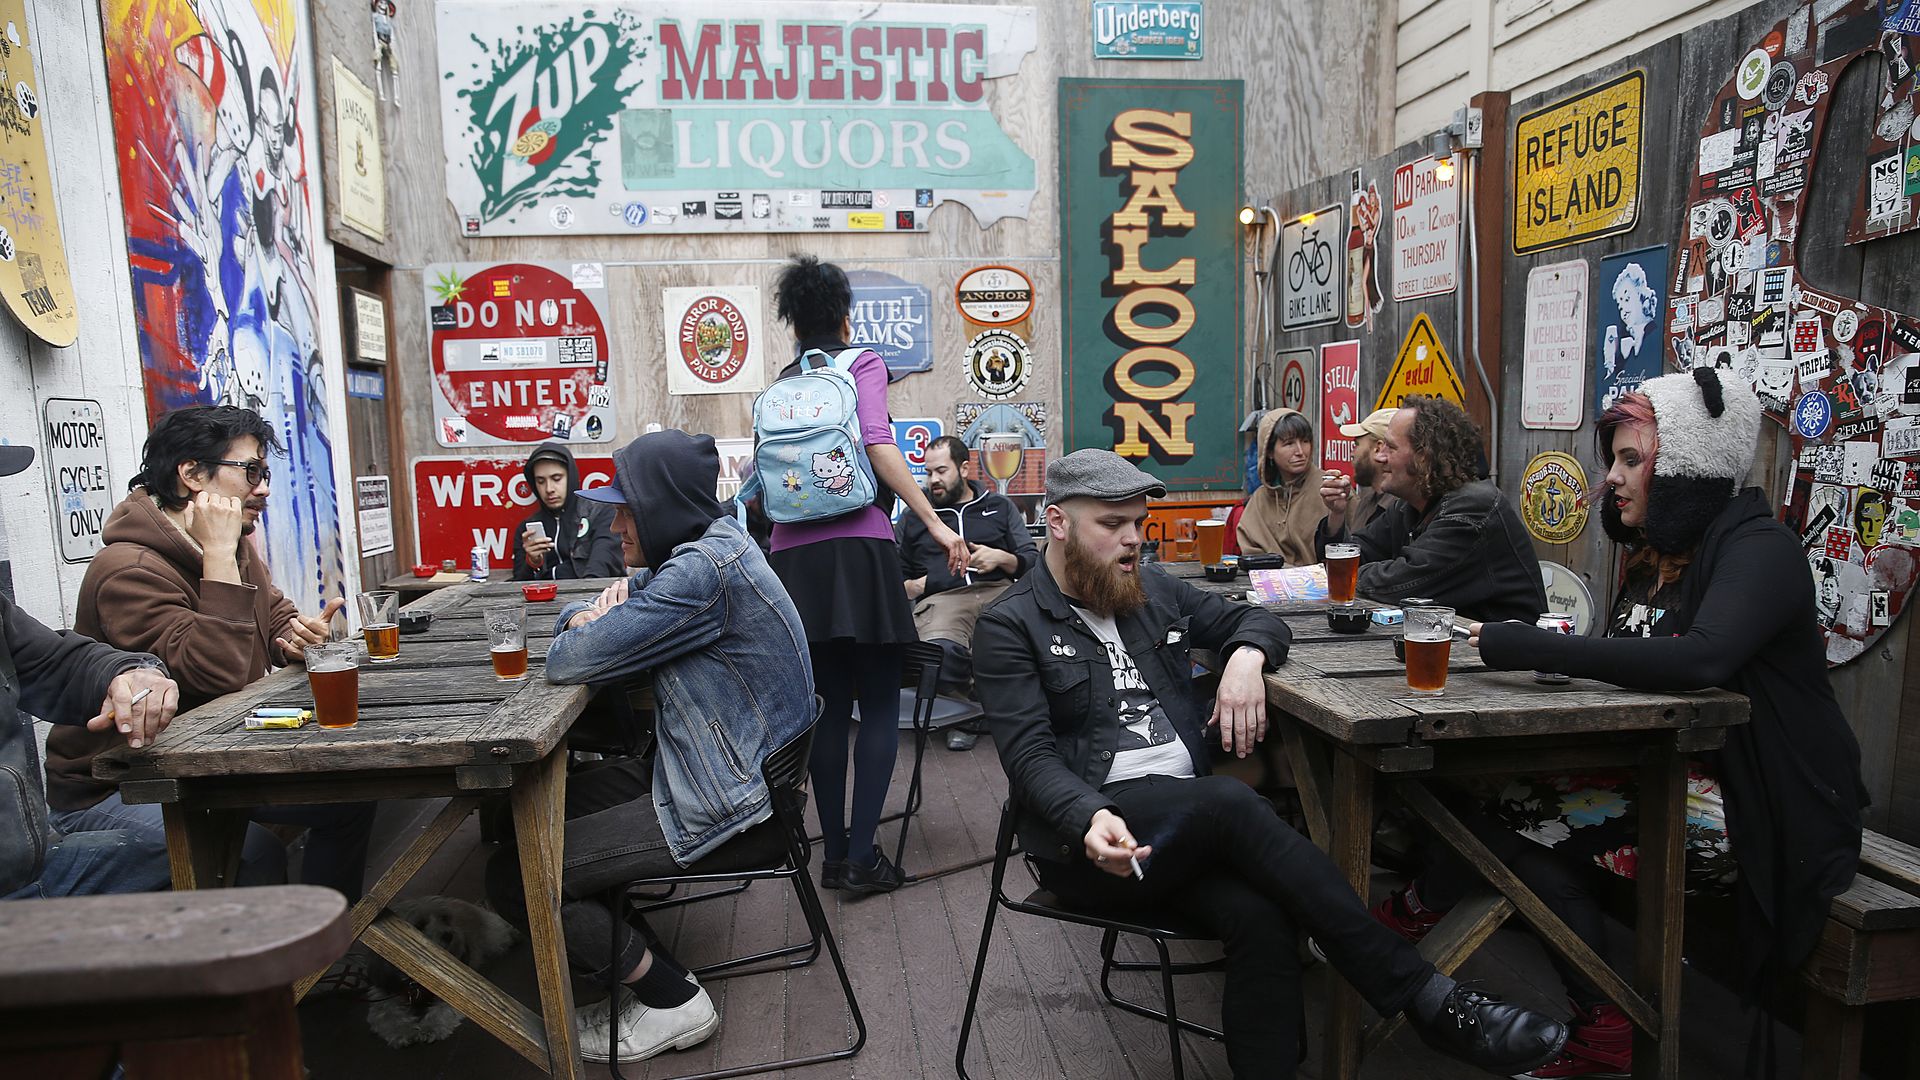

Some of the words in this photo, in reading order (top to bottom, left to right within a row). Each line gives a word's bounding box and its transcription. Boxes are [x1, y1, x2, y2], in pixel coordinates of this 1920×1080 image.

[1097, 3, 1199, 45] Underberg
[660, 23, 984, 103] MAJESTIC
[342, 97, 374, 141] JAMESON
[485, 24, 611, 197] 7UP
[676, 119, 972, 178] LIQUORS
[1526, 102, 1628, 175] REFUGE
[1875, 160, 1899, 179] NC
[1396, 168, 1412, 206] NO
[1526, 166, 1622, 228] ISLAND
[1428, 204, 1439, 232] 12
[1876, 198, 1897, 215] 17
[1402, 239, 1447, 269] THURSDAY
[963, 290, 1028, 301] ANCHOR
[1109, 108, 1196, 458] SALOON
[1397, 279, 1419, 295] STREET
[1422, 272, 1452, 290] CLEANING
[20, 285, 58, 318] TEAM
[457, 300, 499, 329] DO
[514, 298, 577, 328] NOT
[849, 296, 924, 325] MUEL
[1289, 298, 1306, 320] BIKE
[1309, 290, 1333, 317] LANE
[682, 298, 719, 343] MIRROR
[720, 304, 745, 342] POND
[1532, 323, 1578, 345] VEHICLES
[690, 358, 718, 380] PALE
[1325, 365, 1359, 394] STELLA
[1405, 360, 1434, 386] extol
[1799, 355, 1831, 377] TRIPLE
[469, 378, 578, 408] ENTER
[1286, 377, 1300, 402] 40
[50, 421, 103, 449] MOTOR-
[905, 425, 932, 466] 3
[1325, 440, 1356, 462] ARTOIS
[60, 465, 105, 494] CYCLE
[429, 474, 612, 508] WROG
[1526, 466, 1548, 494] ANCHOR
[1547, 463, 1569, 483] STEAM
[1567, 476, 1583, 501] BEER
[70, 508, 104, 537] ONLY
